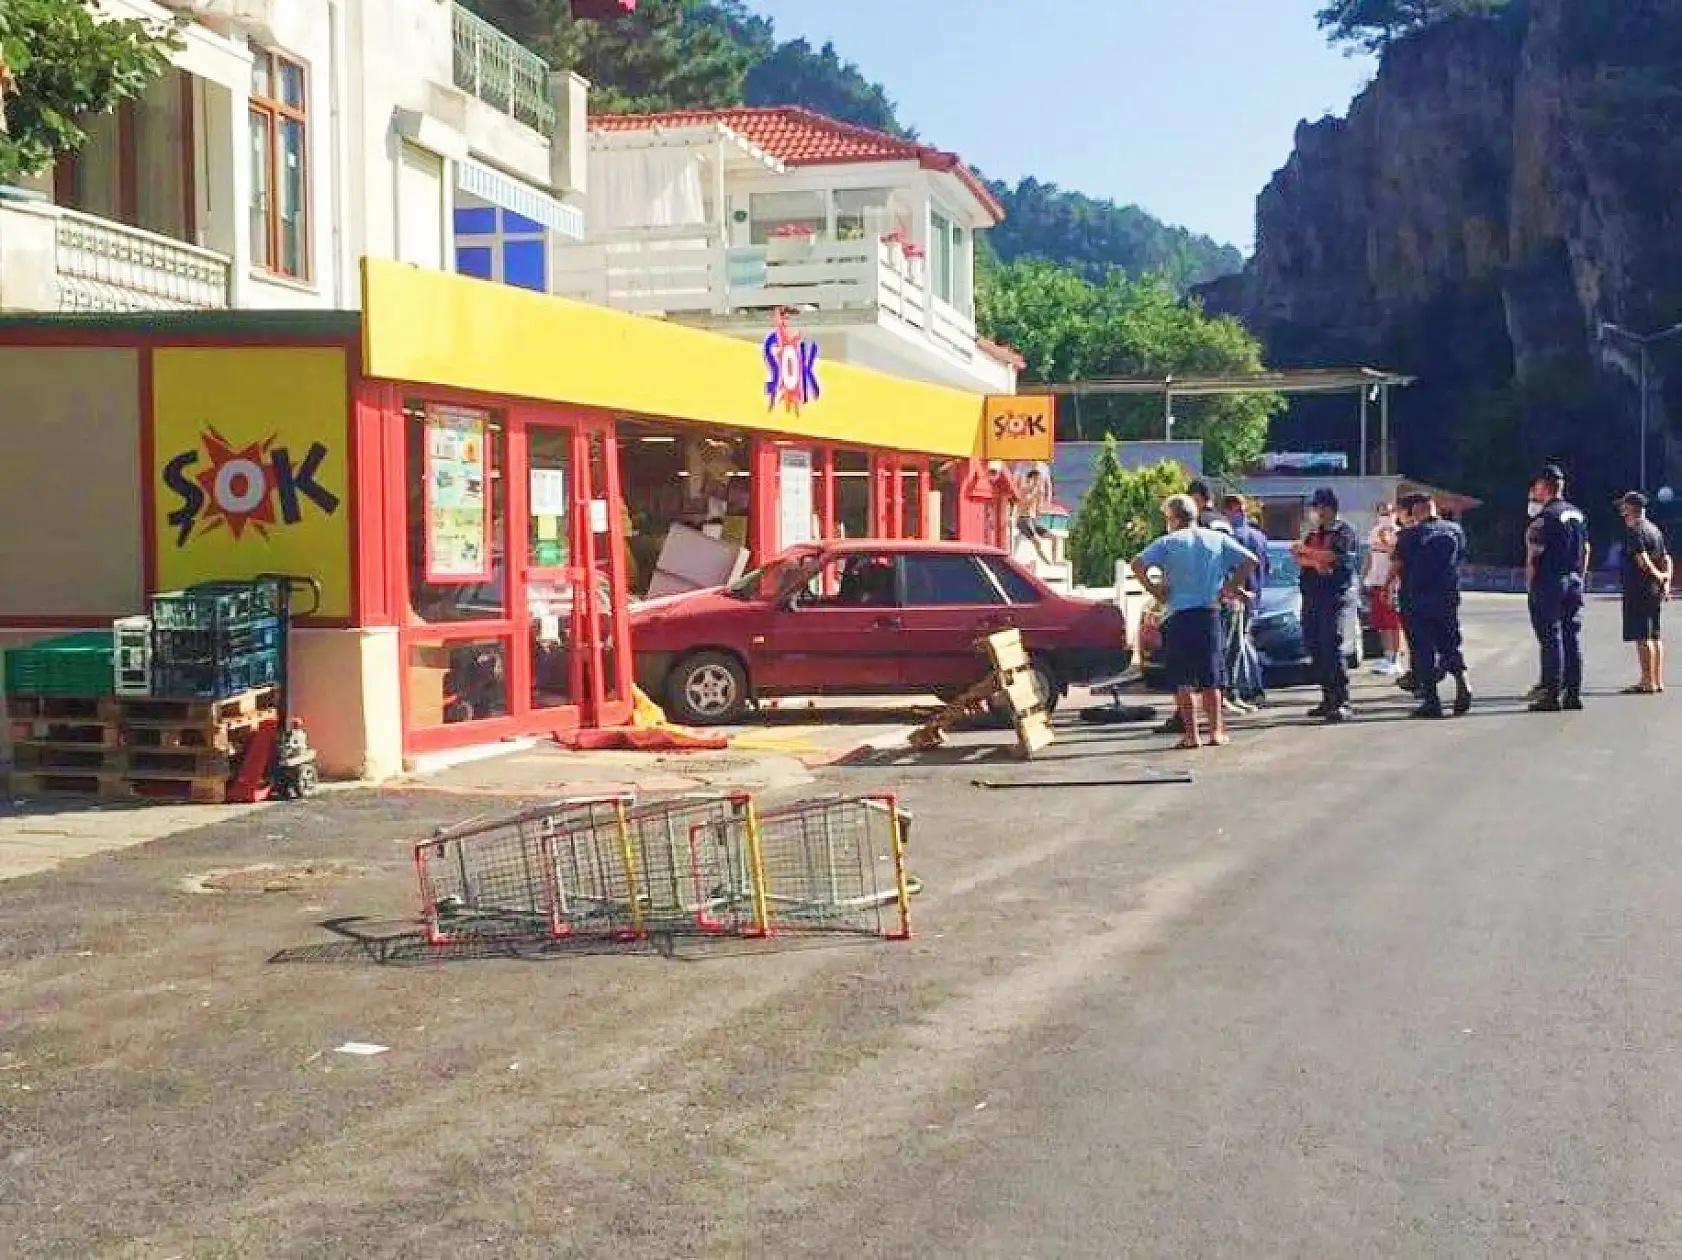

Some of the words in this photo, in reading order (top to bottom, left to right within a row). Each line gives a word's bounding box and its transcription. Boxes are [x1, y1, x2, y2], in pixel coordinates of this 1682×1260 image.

[763, 331, 819, 411] ŞOK
[994, 413, 1046, 442] ŞOK
[162, 441, 340, 548] ŞOK
